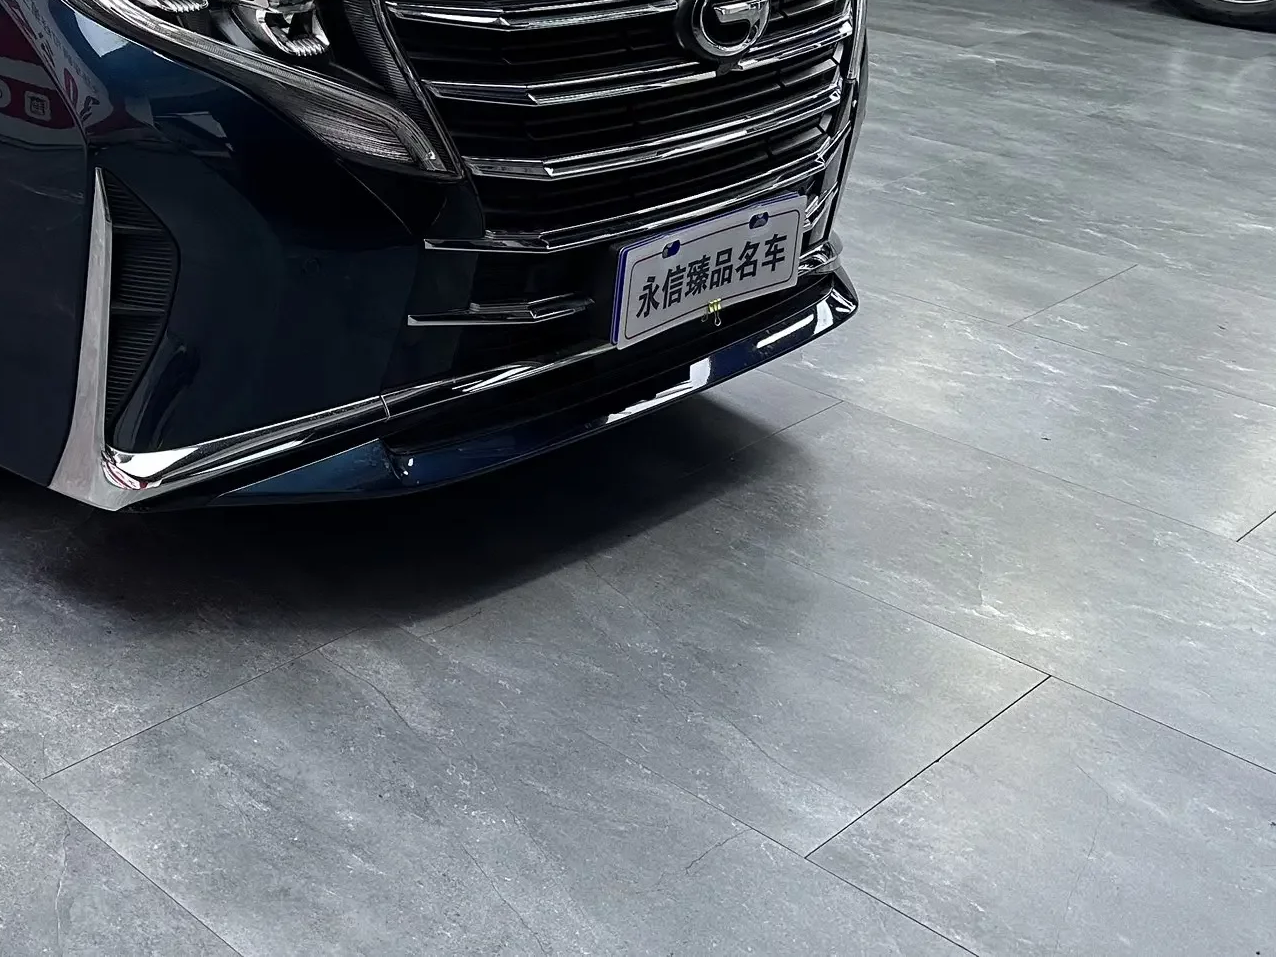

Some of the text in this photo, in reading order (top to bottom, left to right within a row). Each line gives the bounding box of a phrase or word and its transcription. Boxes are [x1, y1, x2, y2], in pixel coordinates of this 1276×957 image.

[636, 234, 787, 319] 永信臻品名车
